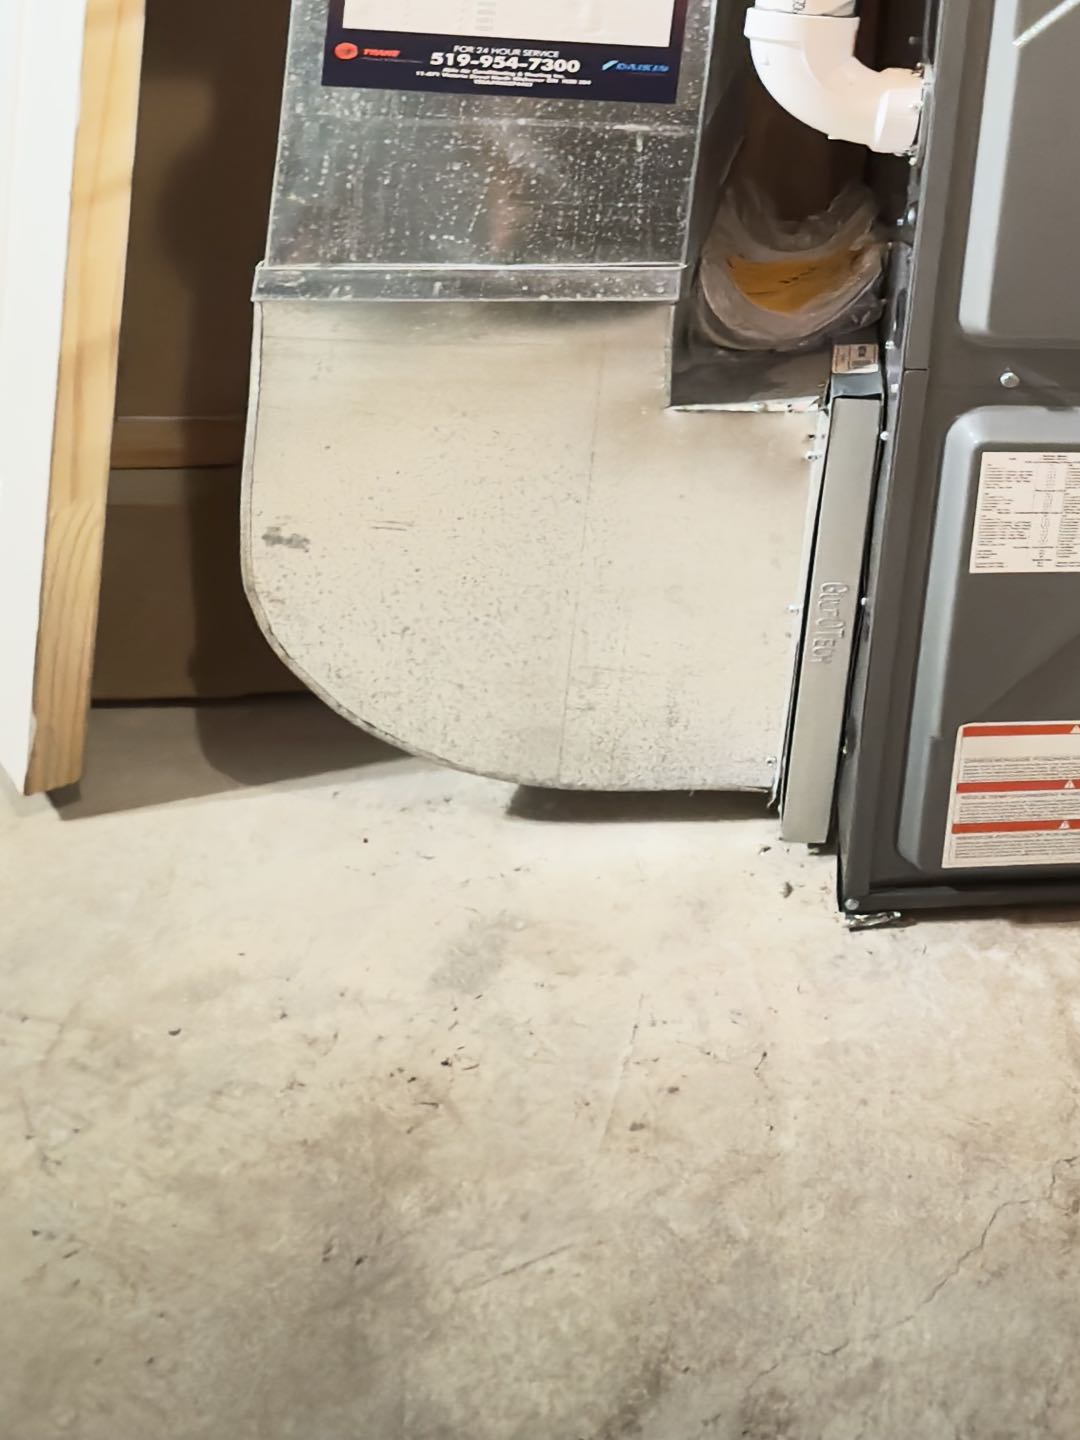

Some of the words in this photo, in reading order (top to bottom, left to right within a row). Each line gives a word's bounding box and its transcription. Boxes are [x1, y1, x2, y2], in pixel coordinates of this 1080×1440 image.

[452, 44, 475, 54] FOR
[475, 45, 490, 54] 24
[490, 46, 521, 56] HOUR
[522, 48, 560, 59] SERVICE
[428, 49, 582, 75] 519-954-7300
[615, 62, 670, 73] DAIKIN
